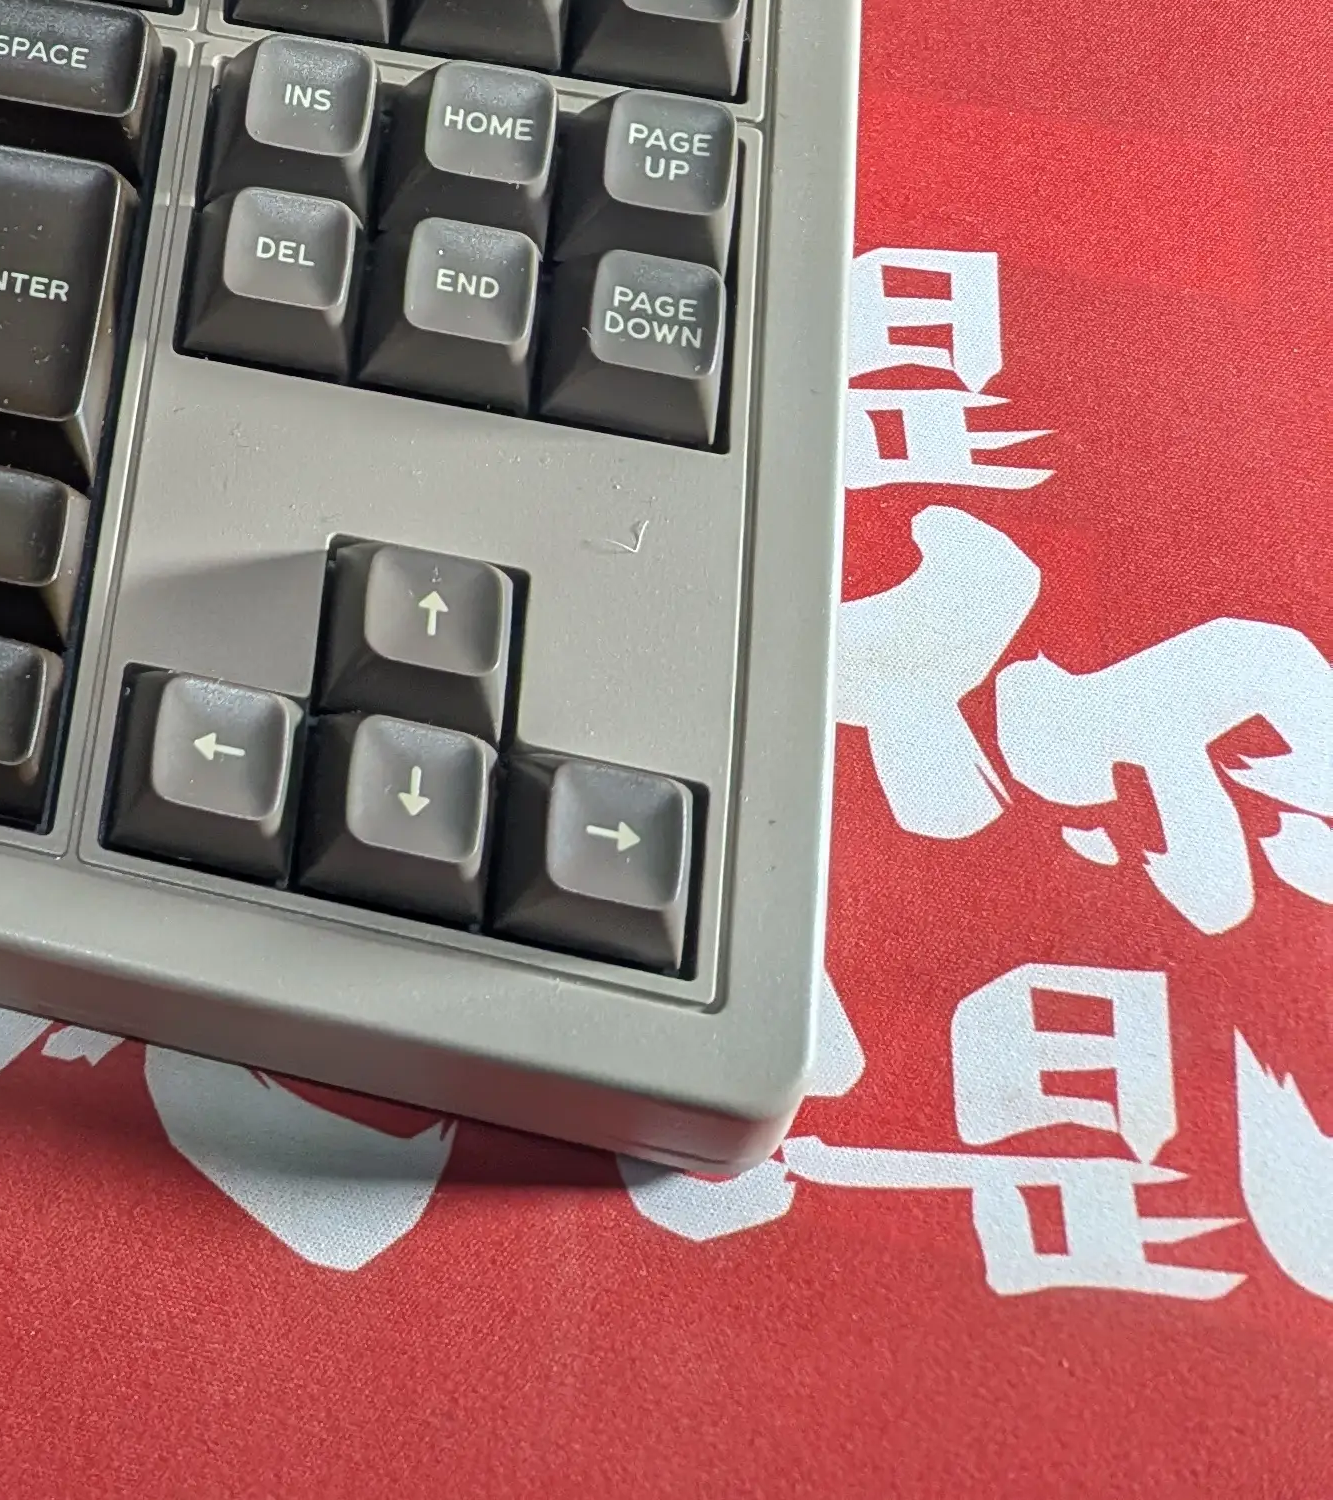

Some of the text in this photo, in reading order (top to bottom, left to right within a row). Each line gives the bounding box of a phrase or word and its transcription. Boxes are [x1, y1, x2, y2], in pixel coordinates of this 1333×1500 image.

[284, 83, 331, 111] INS
[444, 105, 534, 141] HOME
[628, 122, 711, 156] PAGE
[644, 155, 690, 181] UP
[256, 236, 315, 266] DEL
[436, 268, 499, 299] END
[612, 285, 698, 322] PAGE
[603, 311, 702, 348] DOWN
